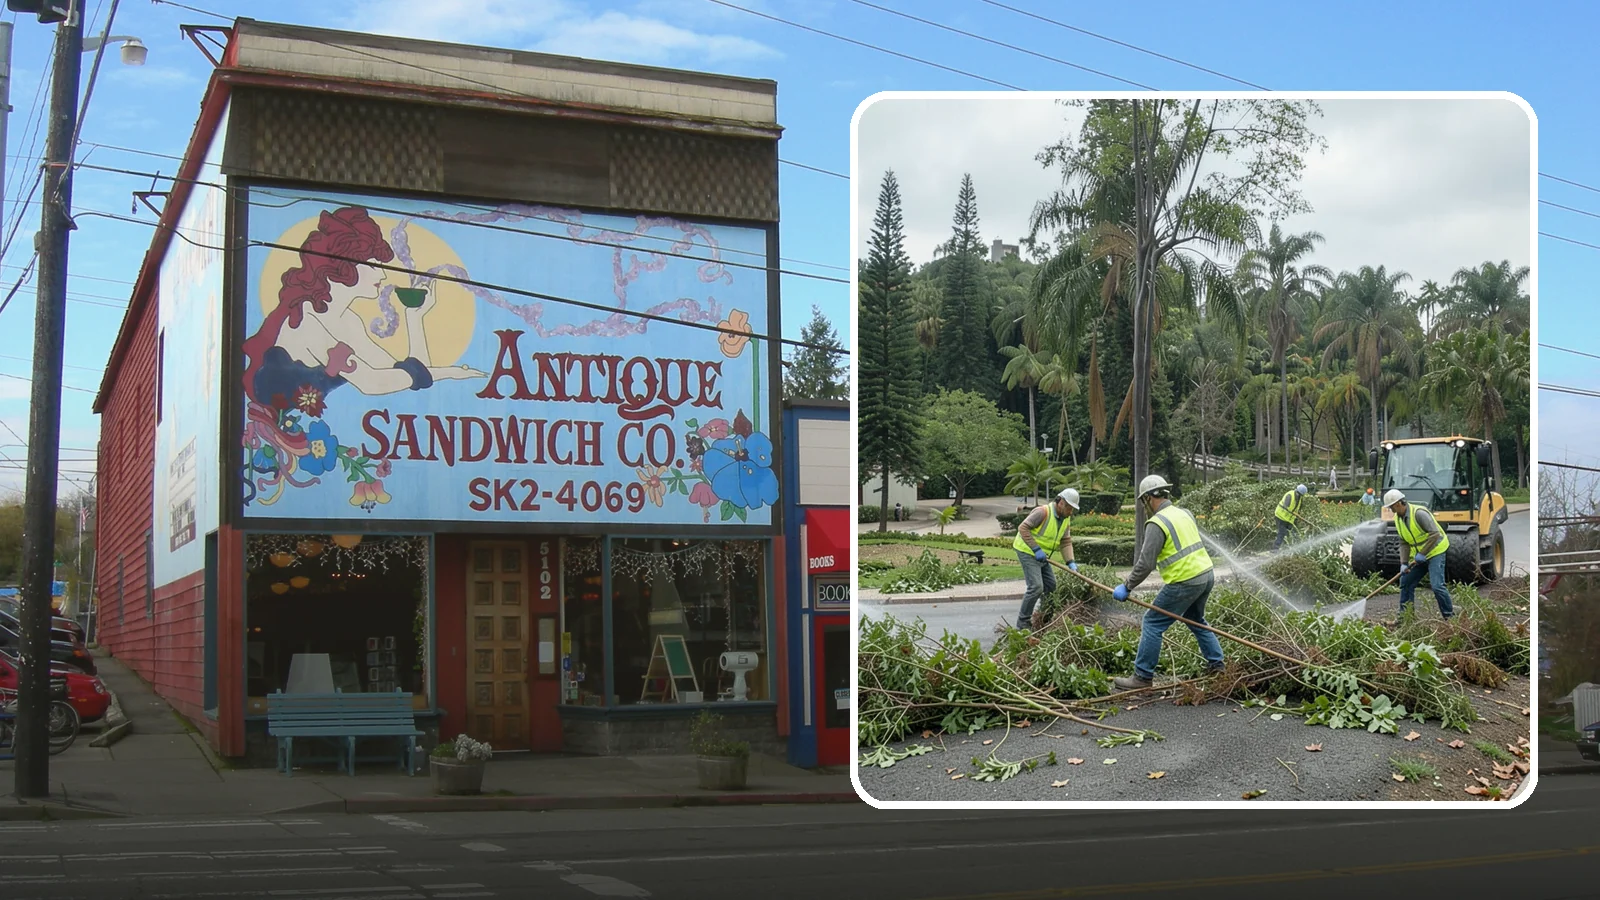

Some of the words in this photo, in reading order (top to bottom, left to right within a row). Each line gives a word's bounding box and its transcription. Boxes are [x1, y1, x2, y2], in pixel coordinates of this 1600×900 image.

[476, 329, 724, 421] ANTIQUE
[361, 408, 604, 467] SANDWICH
[616, 421, 685, 469] CO.
[468, 477, 646, 513] SK2-4069
[540, 541, 551, 599] 5102
[809, 555, 835, 569] BOOKS
